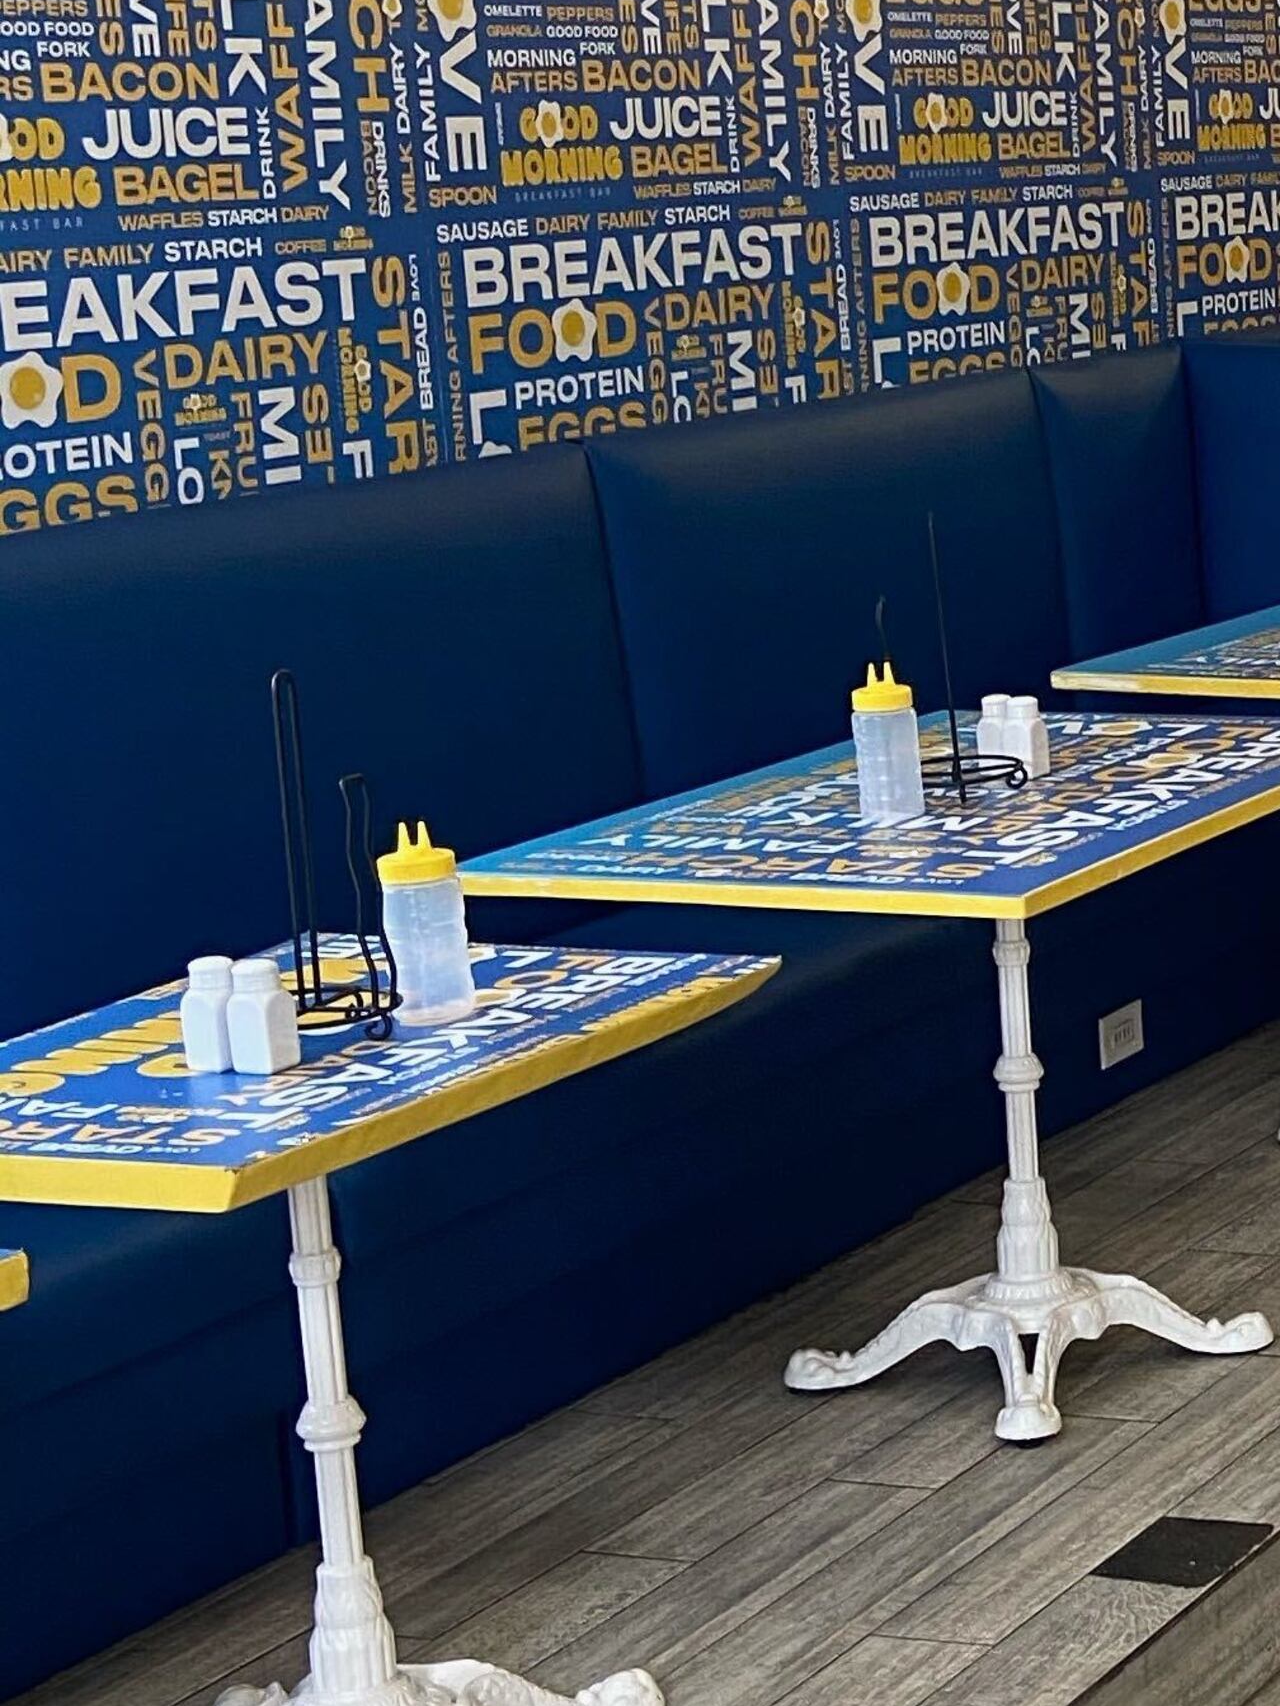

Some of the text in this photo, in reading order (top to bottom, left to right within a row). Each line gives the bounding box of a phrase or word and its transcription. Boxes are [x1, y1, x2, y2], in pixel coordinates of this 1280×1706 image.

[483, 4, 614, 22] OMELETTE PEPPERS
[546, 26, 618, 38] GOOD FOOD
[486, 50, 576, 67] MORNING
[579, 42, 616, 55] FORK
[890, 50, 957, 65] MORNING
[41, 63, 220, 102] BACON
[488, 70, 578, 93] AFTERS
[581, 59, 702, 92] BACON
[891, 68, 958, 87] AFTERS
[961, 59, 1051, 87] BACON
[607, 95, 723, 140] JUICE
[979, 90, 1067, 128] JUICE
[78, 106, 251, 161] JUICE
[898, 132, 992, 166] MORNING
[996, 130, 1070, 160] BAGEL
[499, 145, 624, 186] MORNING
[630, 142, 729, 179] BAGEL
[844, 165, 897, 184] SPOON
[113, 162, 259, 207] BAGEL
[428, 185, 498, 207] SPOON
[870, 201, 1128, 268] BREAKFAST
[462, 222, 805, 309] BREAKFAST
[1107, 797, 1190, 833] STARCH
[578, 833, 858, 854] FAMILY
[623, 851, 999, 882] STARCH
[215, 954, 680, 1131] BREAKFAST
